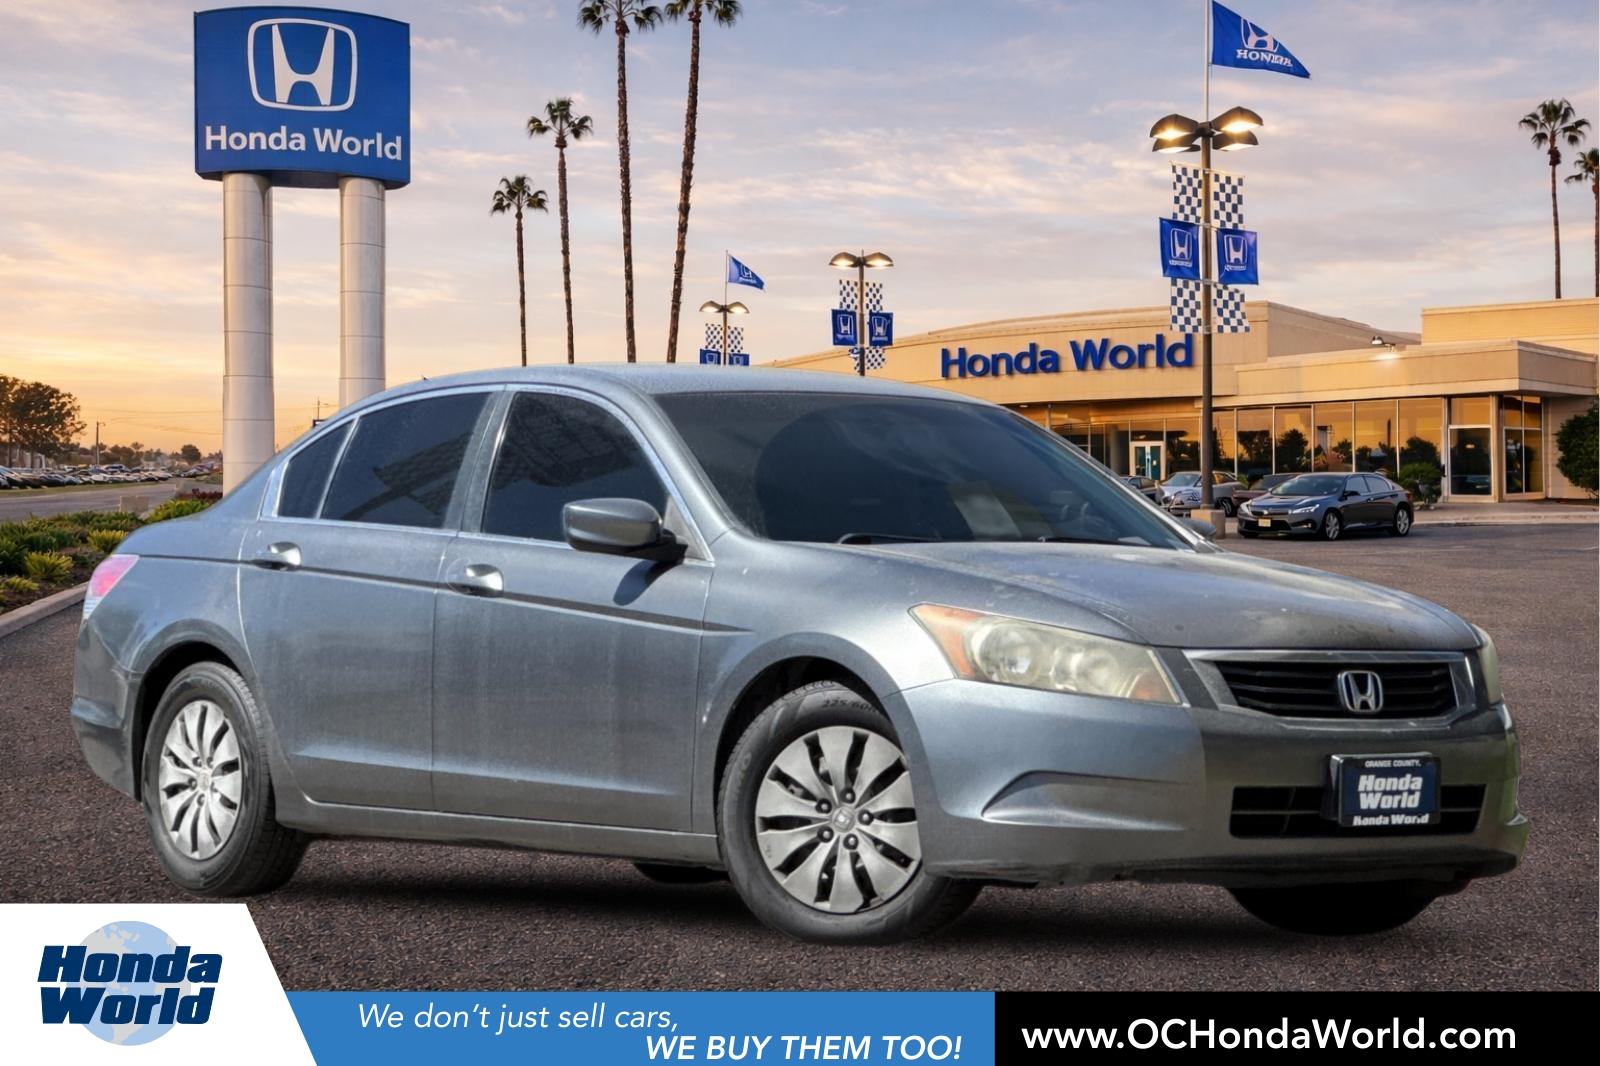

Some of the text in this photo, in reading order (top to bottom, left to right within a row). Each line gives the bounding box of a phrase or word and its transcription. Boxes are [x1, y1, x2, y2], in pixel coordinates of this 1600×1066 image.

[205, 125, 402, 161] Honda World
[941, 333, 1194, 379] Honda World
[1358, 774, 1423, 792] Honda
[1360, 791, 1420, 809] World
